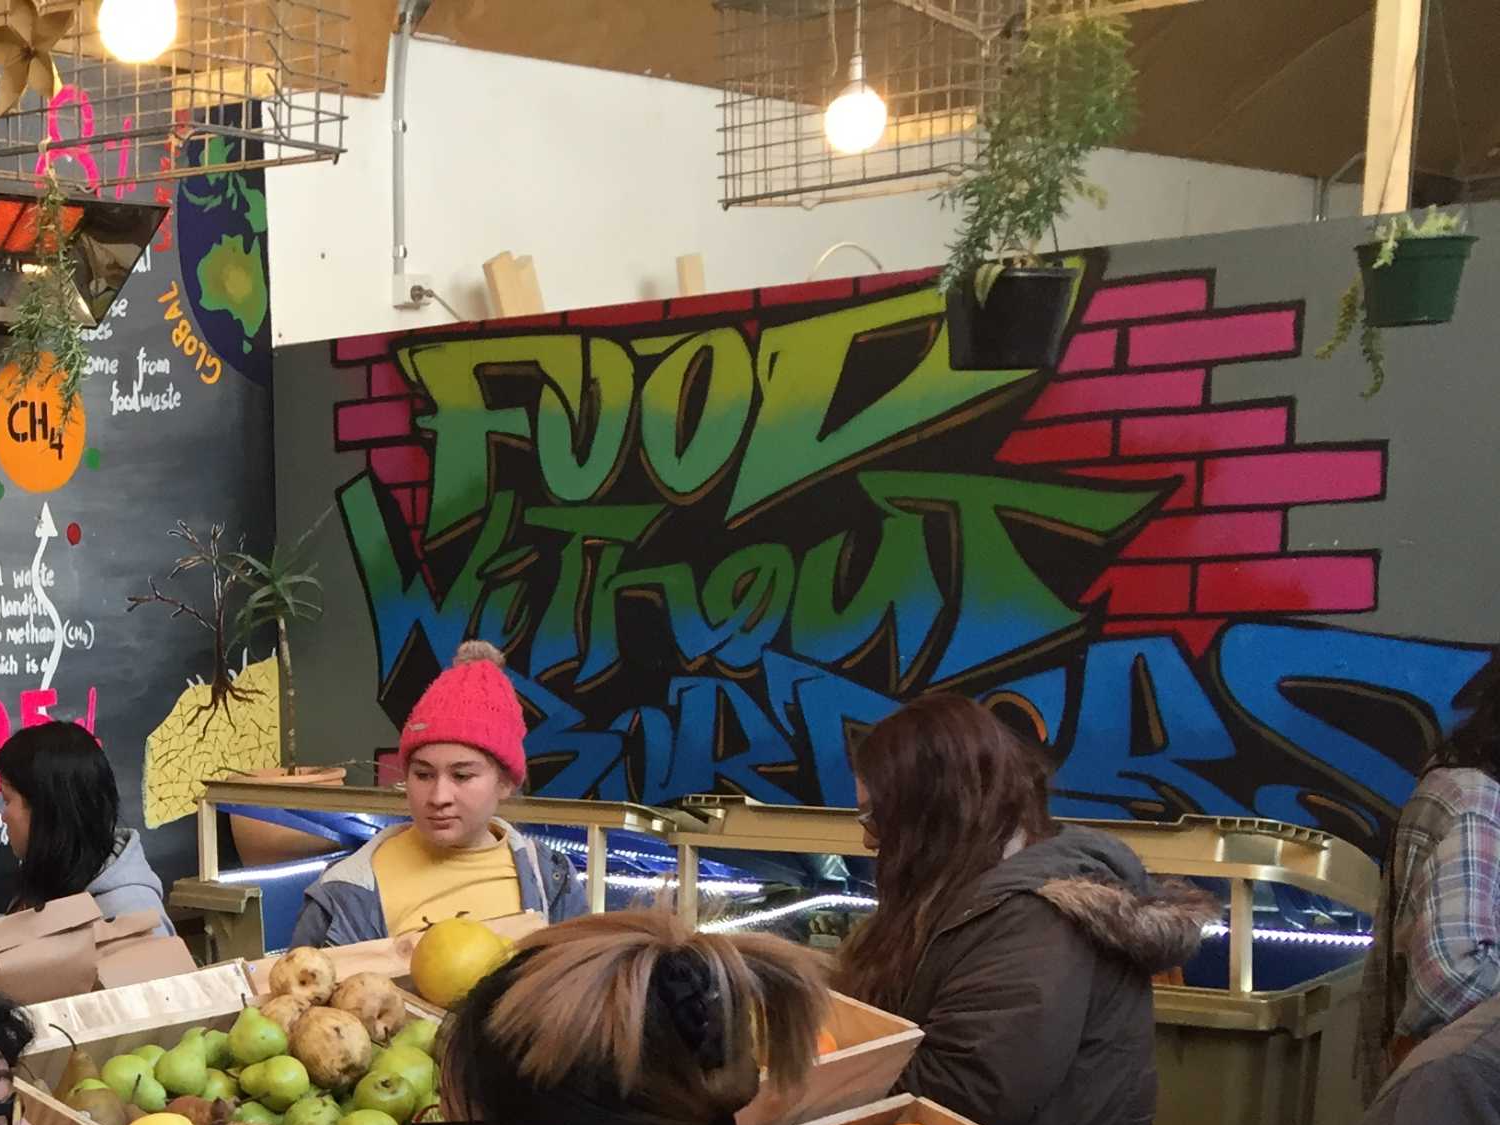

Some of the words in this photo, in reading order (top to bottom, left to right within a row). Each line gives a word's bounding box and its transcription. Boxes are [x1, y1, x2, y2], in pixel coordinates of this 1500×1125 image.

[157, 280, 222, 384] GLOBAL
[137, 346, 170, 392] from
[26, 653, 40, 674] is
